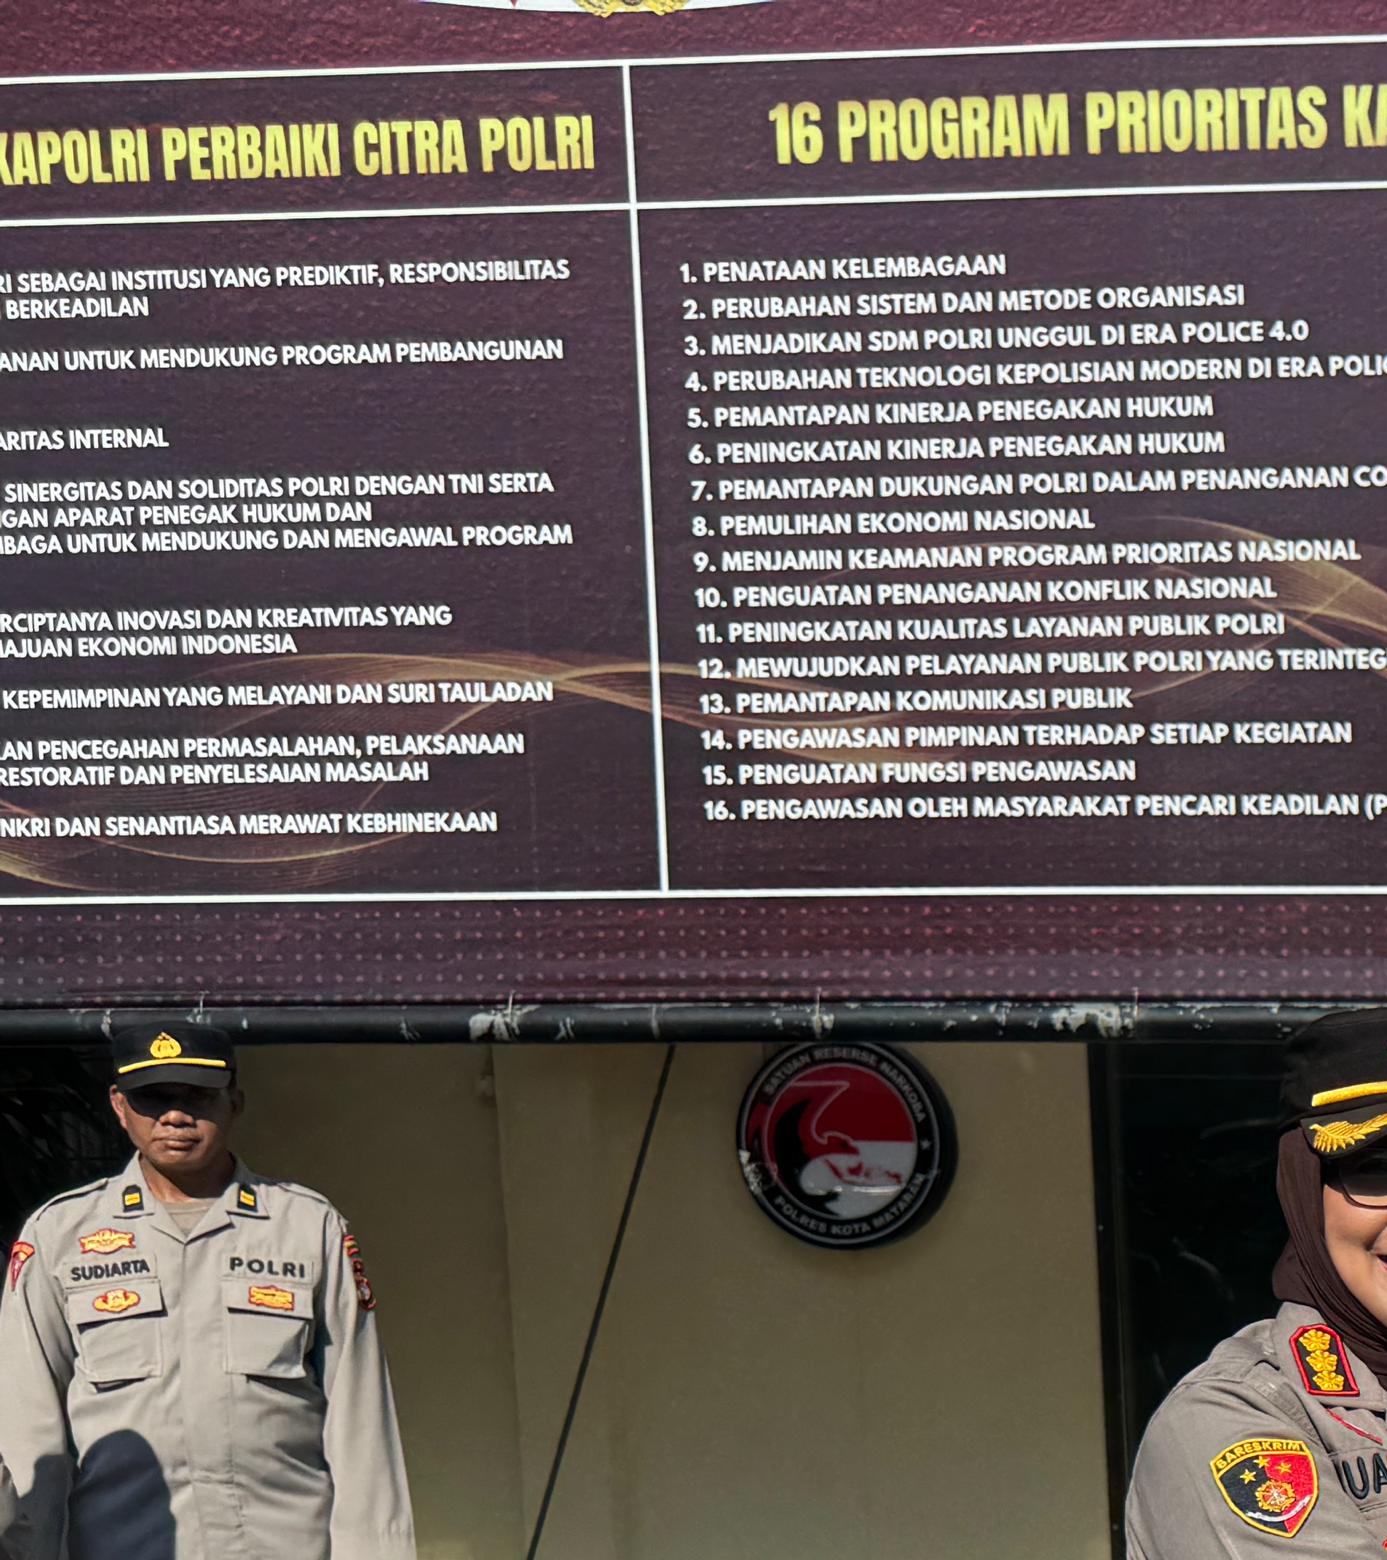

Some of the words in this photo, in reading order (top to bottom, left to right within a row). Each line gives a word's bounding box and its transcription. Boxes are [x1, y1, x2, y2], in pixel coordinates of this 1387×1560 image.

[769, 102, 823, 164] 16
[839, 94, 1069, 162] PROGRAM
[1086, 86, 1327, 153] PRIORITAS
[162, 124, 340, 180] PERBAIKI
[354, 120, 467, 175] CITRA
[480, 115, 594, 171] POLRI
[18, 272, 106, 293] SEBAGAI
[112, 269, 206, 290] INSTITUSI
[209, 267, 270, 287] YANG
[276, 264, 385, 287] PREDIKTIF,
[390, 259, 570, 283] RESPONSIBILITAS
[680, 264, 697, 282] 1.
[704, 260, 825, 282] PENATAAN
[832, 254, 1005, 279] KELEMBAGAAN
[6, 297, 148, 319] BERKEADILAN
[683, 299, 705, 319] 2.
[712, 296, 850, 318] PERUBAHAN
[857, 293, 936, 315] SISTEM
[942, 292, 992, 312] DAN
[999, 289, 1091, 311] METODE
[1097, 285, 1244, 308] ORGANISASI
[64, 350, 136, 370] UNTUK
[141, 346, 277, 368] MENDUKUNG
[282, 344, 391, 365] PROGRAM
[396, 339, 563, 362] PEMBANGUNAN
[685, 372, 707, 391] 4.
[714, 369, 851, 391] PERUBAHAN
[856, 365, 990, 387] TEKNOLOGI
[997, 361, 1134, 384] KEPOLISIAN
[1141, 359, 1241, 380] MODERN
[1248, 358, 1271, 378] DI
[1278, 357, 1324, 377] ERA
[688, 408, 708, 427] 5.
[715, 404, 869, 427] PEMANTAPAN
[876, 402, 973, 423] KINERJA
[978, 398, 1120, 421] PENEGAKAN
[1127, 396, 1213, 417] HUKUM
[69, 428, 169, 449] INTERNAL
[5, 481, 122, 502] SINERGITAS
[128, 480, 172, 499] DAN
[178, 478, 283, 498] SOLIDITAS
[289, 477, 349, 496] POLRI
[355, 475, 444, 495] DENGAN
[448, 474, 483, 493] TNI
[489, 473, 554, 493] SERTA
[693, 517, 714, 536] 8.
[721, 514, 851, 535] PEMULIHAN
[858, 511, 968, 533] EKONOMI
[975, 509, 1095, 530] NASIONAL
[695, 587, 727, 607] 10.
[734, 585, 871, 607] PENGUATAN
[878, 582, 1041, 604] PENANGANAN
[1048, 579, 1150, 601] KONFLIK
[1155, 577, 1277, 599] NASIONAL
[117, 610, 201, 630] INOVASI
[207, 609, 252, 628] DAN
[257, 607, 388, 627] KREATIVITAS
[390, 606, 452, 625] YANG
[698, 658, 731, 678] 12.
[737, 656, 900, 678] MEWUJUDKAN
[906, 653, 1041, 675] PELAYANAN
[1048, 652, 1129, 673] PUBLIK
[1134, 651, 1202, 672] POLRI
[1206, 650, 1273, 670] YANG
[3, 688, 160, 709] KEPEMIMPINAN
[163, 687, 223, 706] YANG
[228, 685, 331, 705] MELAYANI
[337, 683, 382, 703] DAN
[388, 683, 435, 703] SURI
[438, 681, 553, 702] TAULADAN
[38, 739, 178, 760] PENCEGAHAN
[184, 736, 361, 758] PERMASALAHAN,
[366, 734, 524, 755] PELAKSANAAN
[701, 730, 732, 749] 14.
[738, 727, 899, 749] PENGAWASAN
[905, 726, 1018, 747] PIMPINAN
[1023, 724, 1145, 745] TERHADAP
[1151, 723, 1229, 744] SETIAP
[1235, 722, 1351, 743] KEGIATAN
[120, 765, 165, 784] DAN
[170, 763, 321, 784] PENYELESAIAN
[326, 761, 428, 781] MASALAH
[704, 801, 735, 820] 16.
[742, 798, 902, 819] PENGAWASAN
[908, 797, 967, 817] OLEH
[973, 795, 1131, 817] MASYARAKAT
[1136, 795, 1235, 815] PENCARI
[1242, 794, 1359, 815] KEADILAN
[0, 818, 50, 837] NKRI
[55, 817, 100, 836] DAN
[105, 815, 236, 836] SENANTIASA
[240, 814, 342, 834] MERAWAT
[347, 812, 497, 832] KEBHINEKAAN
[765, 1055, 813, 1096] SATUAN
[775, 1195, 827, 1234] POLRES
[831, 1222, 871, 1236] KOTA
[70, 1258, 150, 1281] SUDIARTA
[229, 1256, 306, 1279] POLRI
[1215, 1439, 1302, 1470] BARESKRIM
